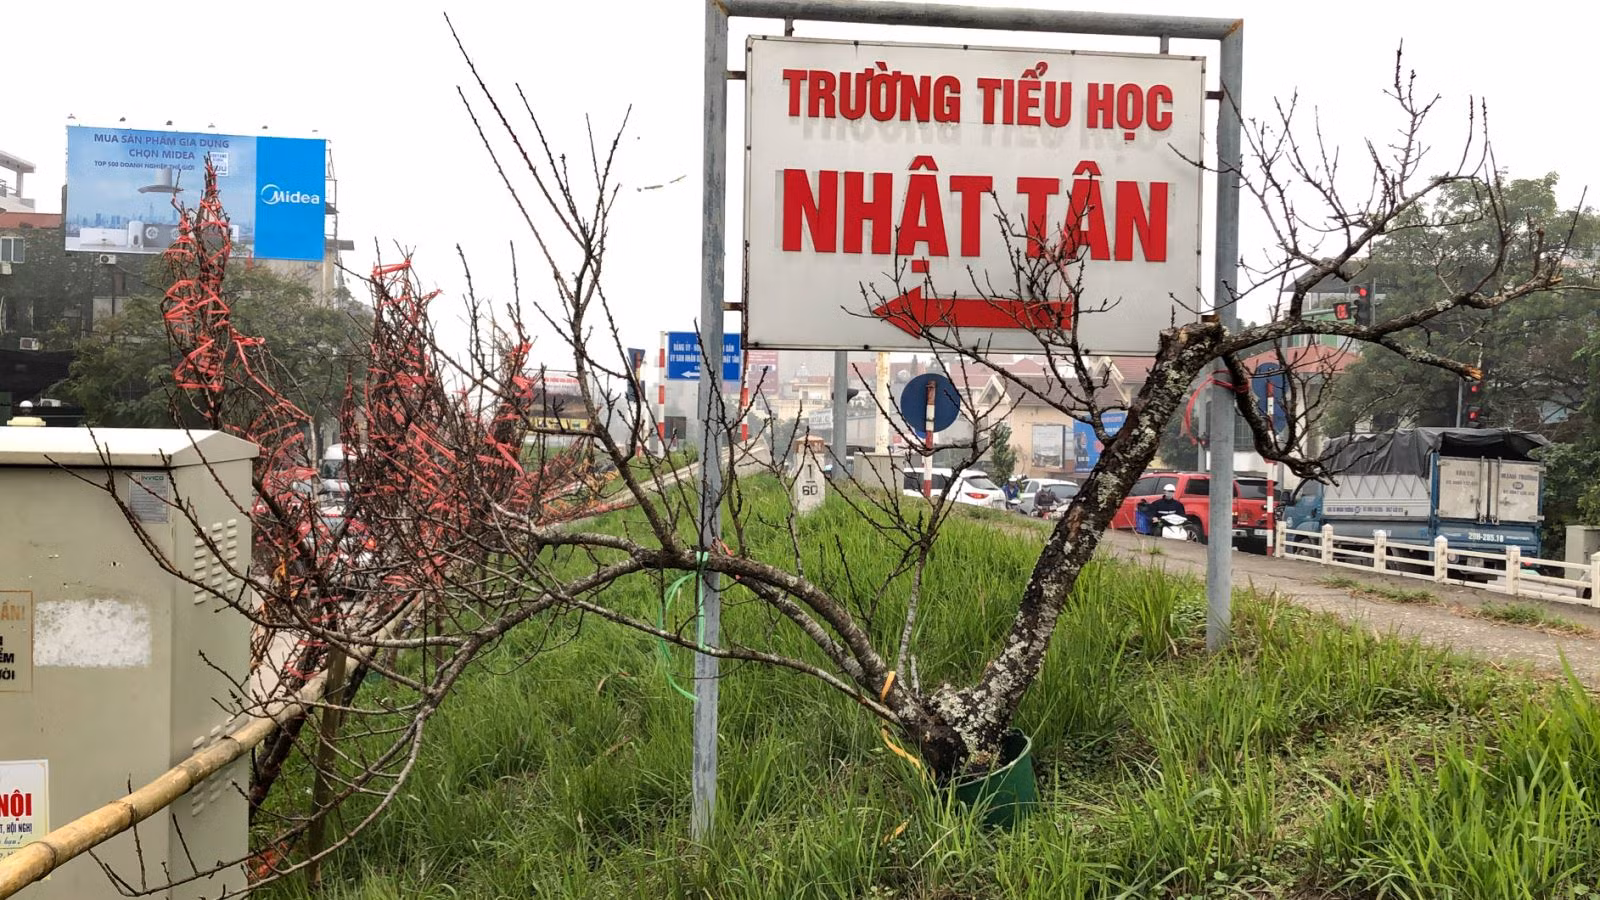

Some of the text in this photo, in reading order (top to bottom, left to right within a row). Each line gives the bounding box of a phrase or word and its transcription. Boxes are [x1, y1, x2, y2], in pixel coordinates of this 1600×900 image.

[783, 61, 1173, 141] TRƯỜNG TIỂU HỌC
[94, 133, 119, 143] MUA
[179, 137, 197, 147] GIA
[200, 138, 229, 149] DỤNG
[129, 149, 195, 160] CHỌN MIDEA
[271, 188, 320, 204] Midea
[782, 155, 1169, 273] NHẬT TÂN
[807, 464, 812, 479] 1
[802, 485, 818, 496] 60
